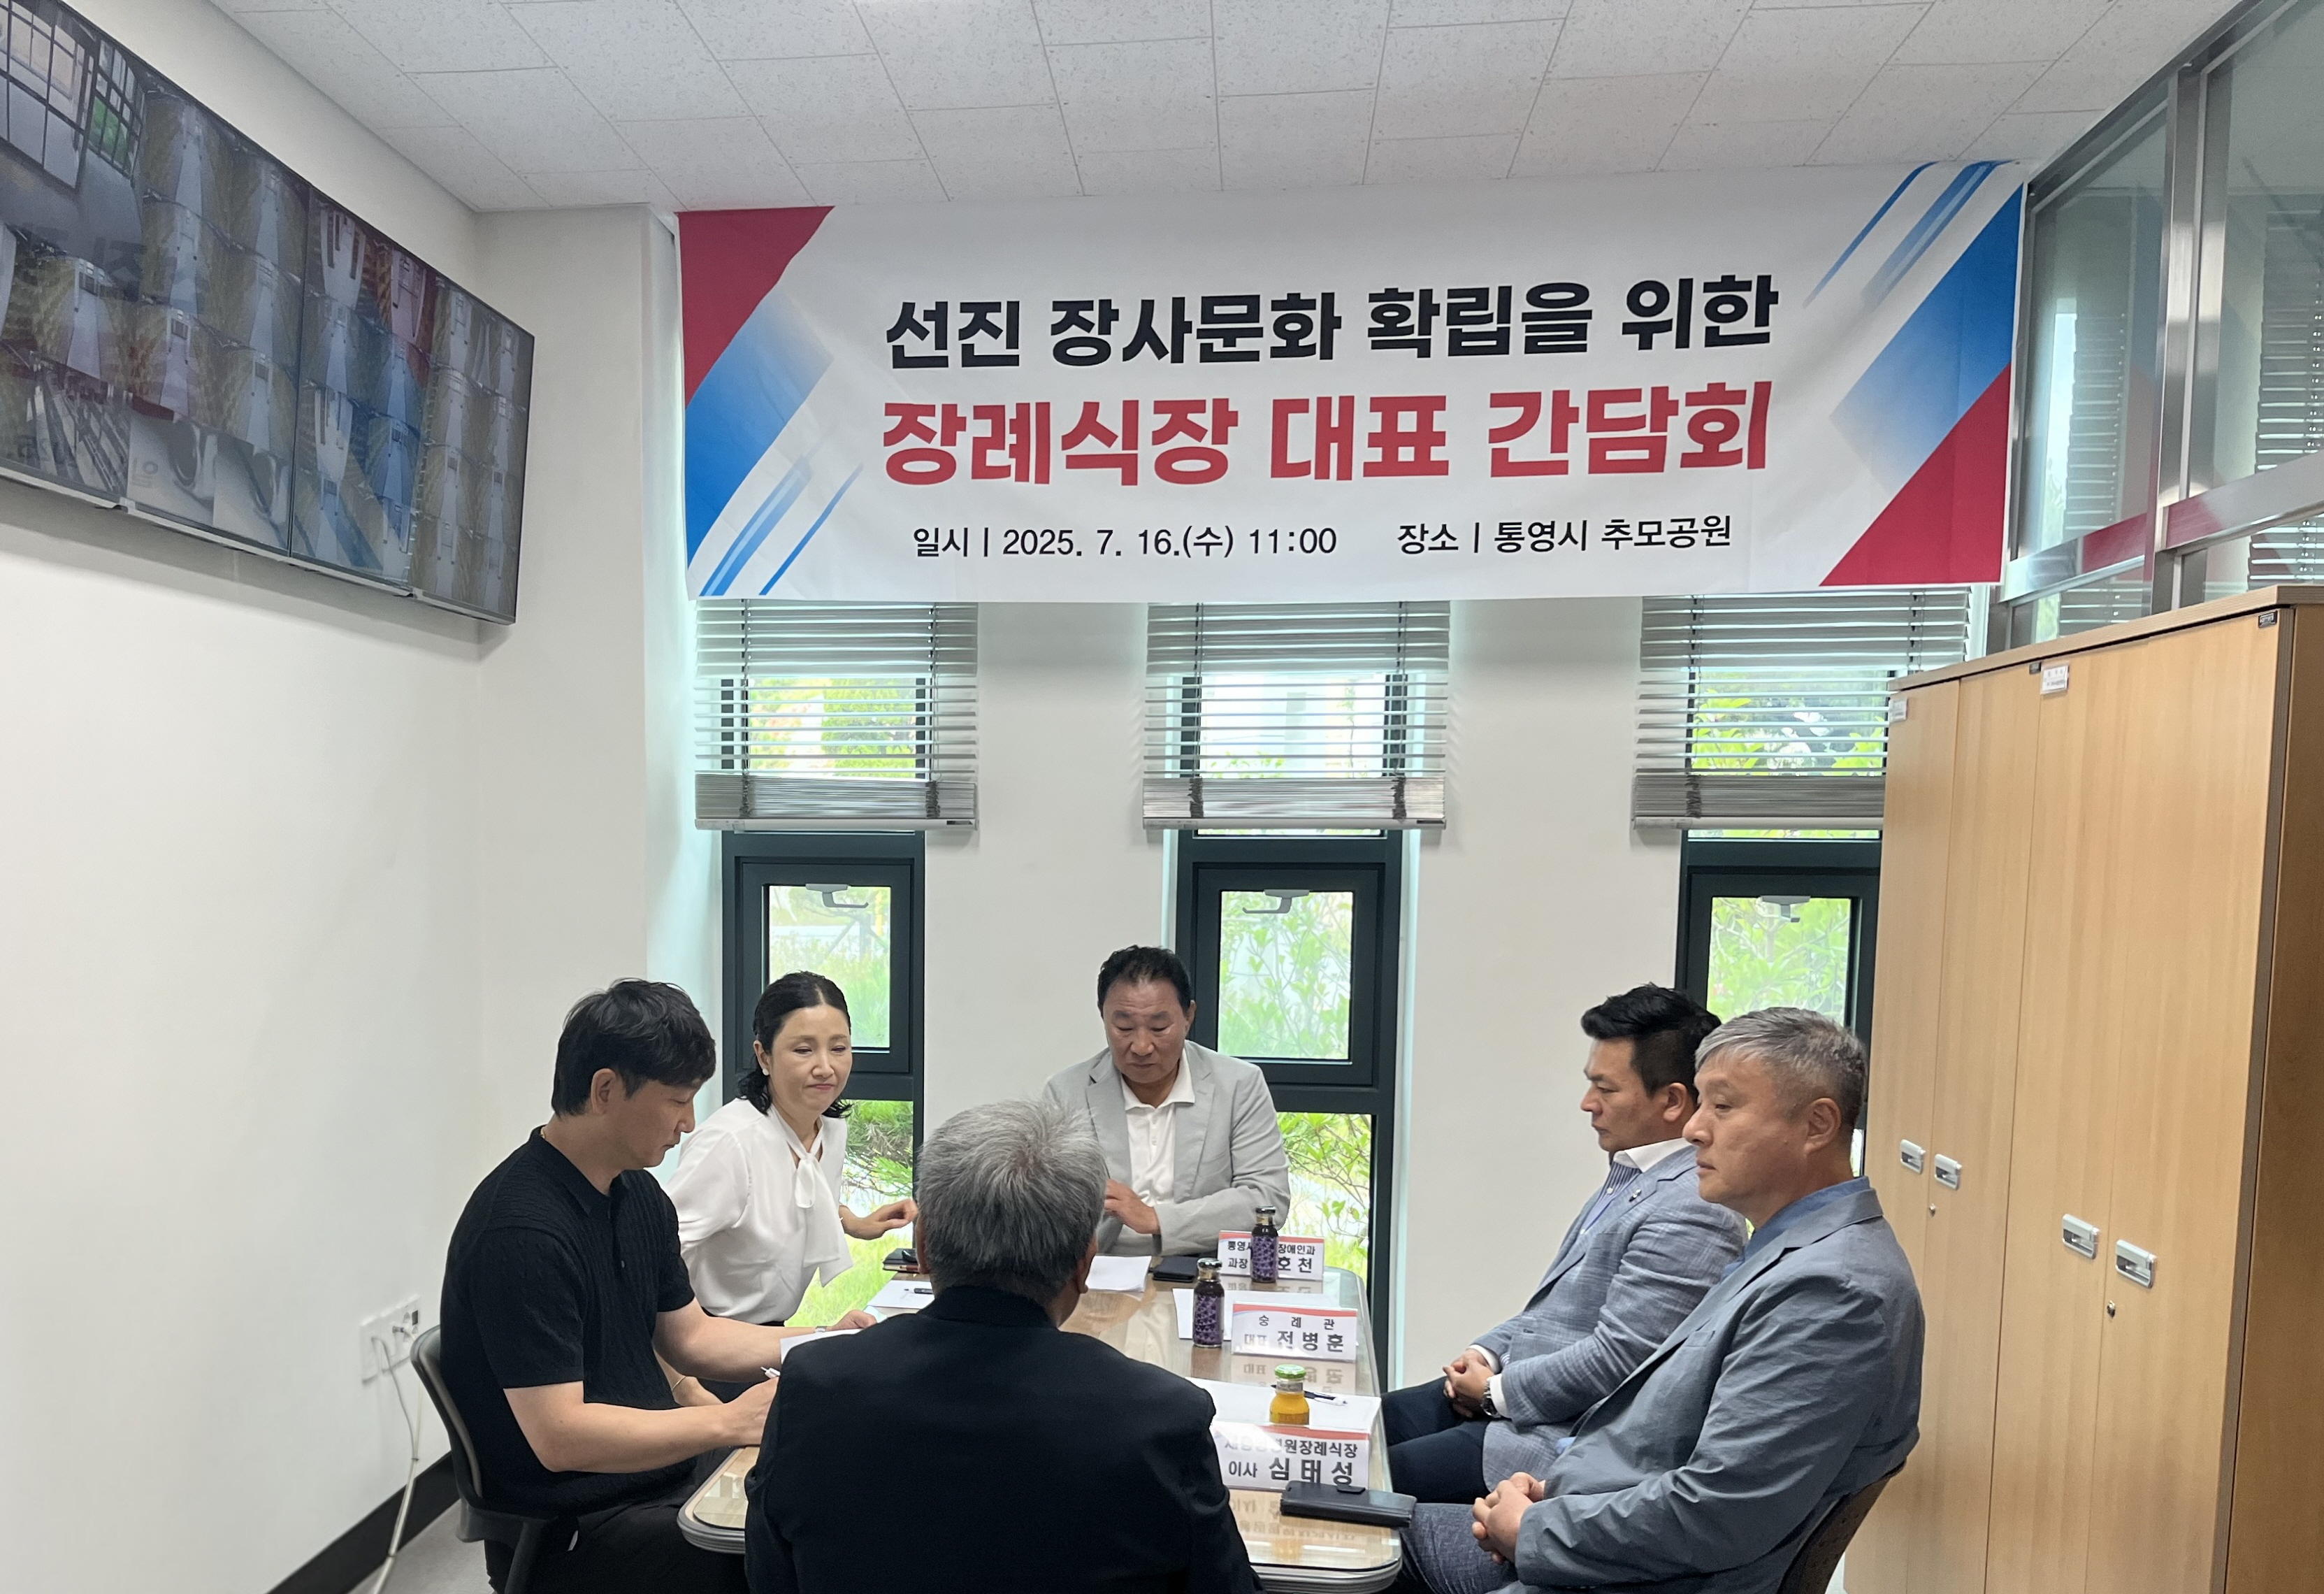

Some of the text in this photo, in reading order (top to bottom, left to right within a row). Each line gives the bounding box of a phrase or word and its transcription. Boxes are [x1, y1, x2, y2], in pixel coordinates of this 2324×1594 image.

[885, 274, 1780, 369] 선진 장사문화 확립을 위한
[883, 380, 1773, 487] 장례식장 대표 간담회
[913, 527, 969, 557] 일시
[1002, 529, 1082, 557] 2025.
[1097, 529, 1122, 557] 7.
[1138, 525, 1234, 559] 16.(수)
[1249, 527, 1337, 554] 11:00
[1397, 523, 1459, 555] 장소
[1494, 519, 1587, 553] 통영시
[1601, 515, 1731, 550] 추모공원
[1228, 1258, 1248, 1269] 과장
[1278, 1244, 1316, 1256] 장애인과
[1228, 1456, 1354, 1486] 이사 심태성
